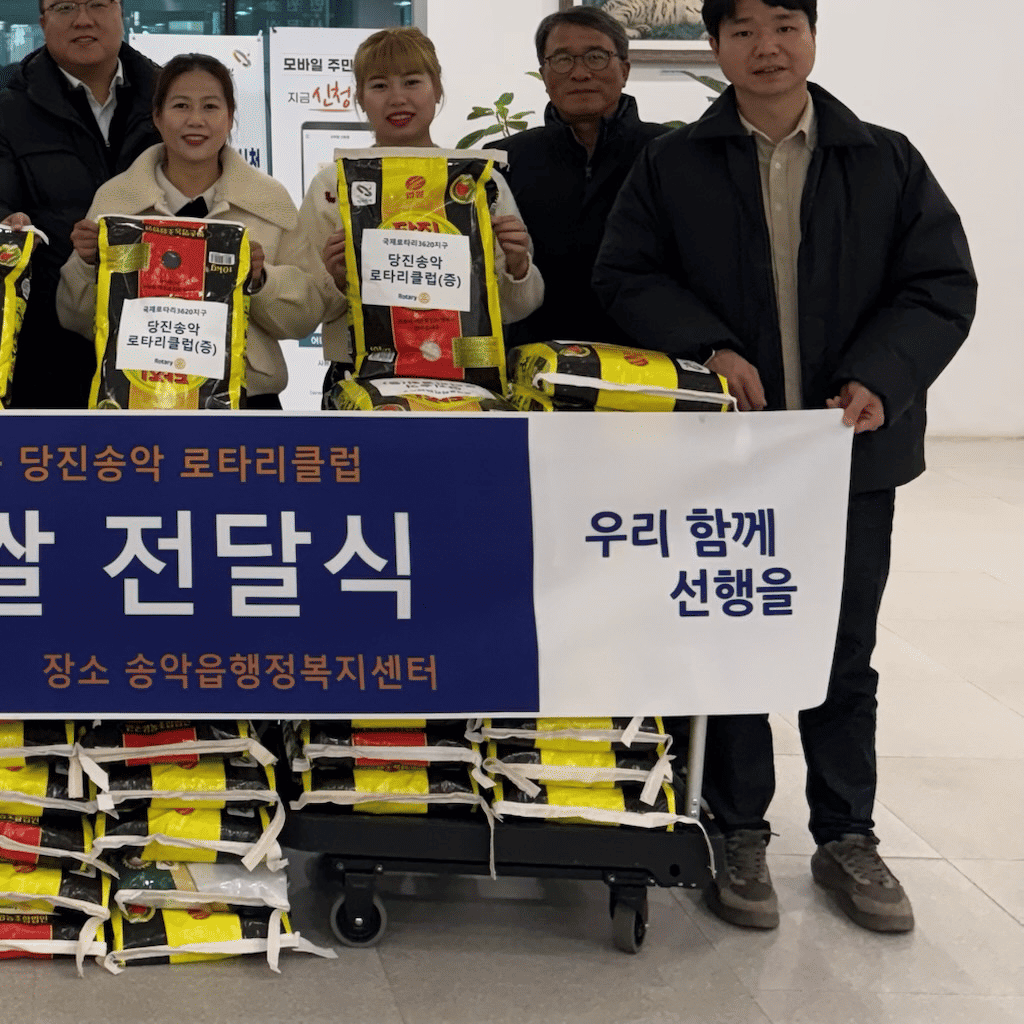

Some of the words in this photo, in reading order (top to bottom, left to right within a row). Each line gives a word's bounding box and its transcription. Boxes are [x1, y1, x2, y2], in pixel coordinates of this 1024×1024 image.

[283, 57, 323, 73] 모바일
[288, 91, 310, 104] 지금
[311, 80, 351, 108] 신청
[382, 237, 449, 249] 국제로타리3620지구
[387, 253, 444, 270] 당진송악
[369, 269, 462, 289] 로타리클럽(증)
[397, 292, 418, 302] Rotary
[143, 305, 207, 317] 국제로타리3620지구
[147, 320, 201, 337] 당진송악
[126, 334, 217, 357] 로타리클럽(증)
[154, 358, 174, 367] Rotary
[20, 444, 164, 483] 당진송악
[180, 445, 361, 483] 로타리클럽
[585, 509, 670, 558] 우리
[685, 508, 775, 558] 함께
[103, 510, 412, 620] 전달식
[670, 567, 798, 617] 선행을
[43, 654, 108, 689] 장소
[125, 654, 437, 690] 송악읍행정복지센터
